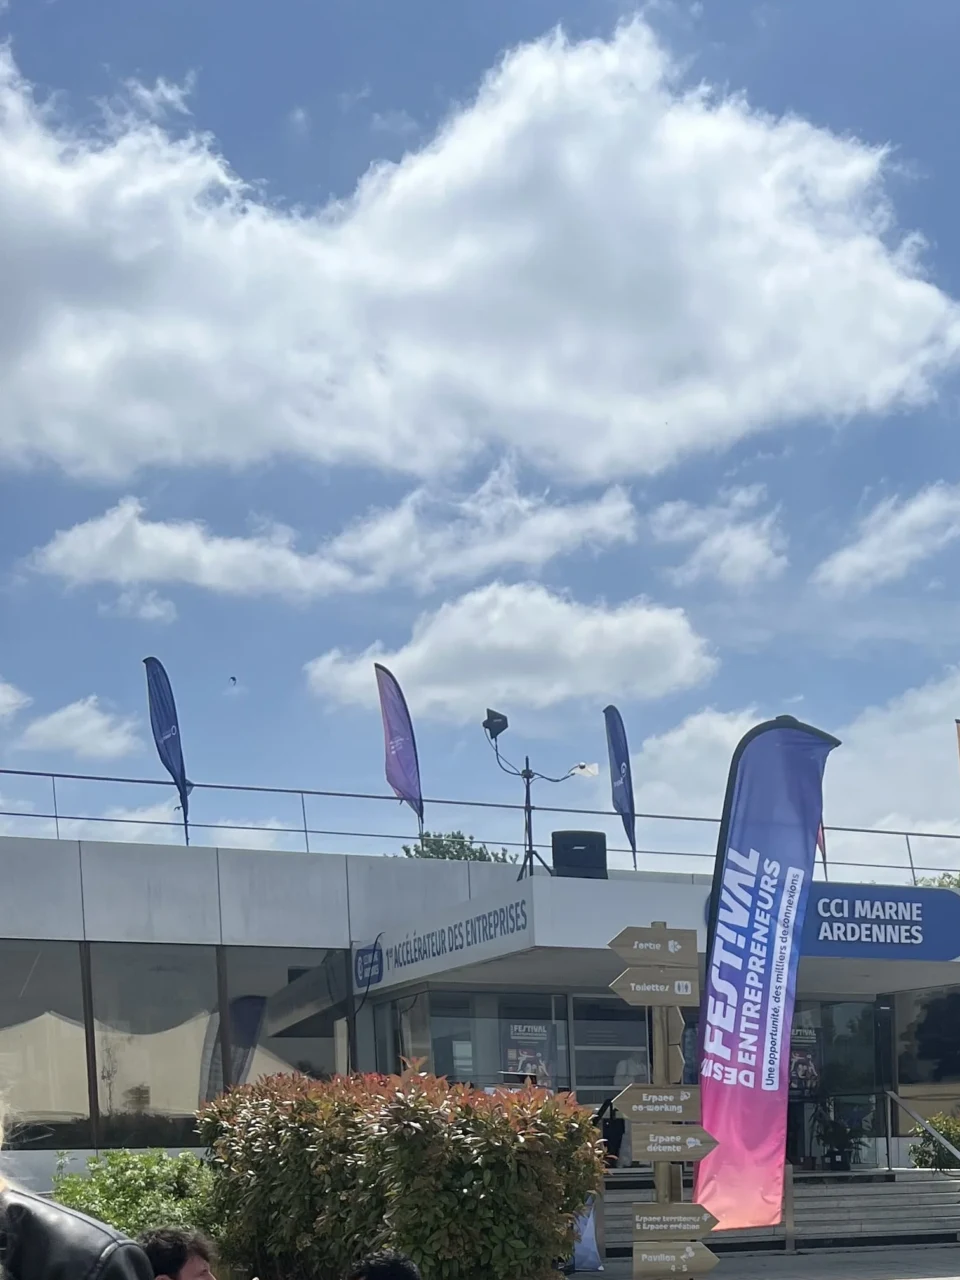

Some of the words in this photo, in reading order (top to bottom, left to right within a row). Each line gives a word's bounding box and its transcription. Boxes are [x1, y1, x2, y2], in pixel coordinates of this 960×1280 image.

[783, 873, 799, 929] connexions
[818, 898, 848, 918] CCI
[854, 900, 922, 921] MARNE
[394, 928, 447, 968] ACCÉLÉRATEUR
[447, 921, 464, 952] DES
[465, 900, 527, 946] ENTREPRISES
[780, 929, 788, 943] de
[818, 922, 924, 944] ARDENNES
[633, 941, 661, 949] Sortie
[738, 858, 780, 1066] ENTREPRENEURS
[775, 945, 787, 986] milliers
[630, 983, 669, 991] Toilettes
[773, 986, 782, 1003] des
[766, 1067, 776, 1085] Une
[642, 1093, 674, 1103] Espace
[632, 1103, 682, 1113] co-working
[649, 1134, 681, 1143] Espace
[647, 1143, 681, 1152] détente
[635, 1215, 661, 1223] Espace
[641, 1253, 676, 1262] Pavillon
[670, 1264, 676, 1272] 4
[682, 1264, 688, 1272] 5
